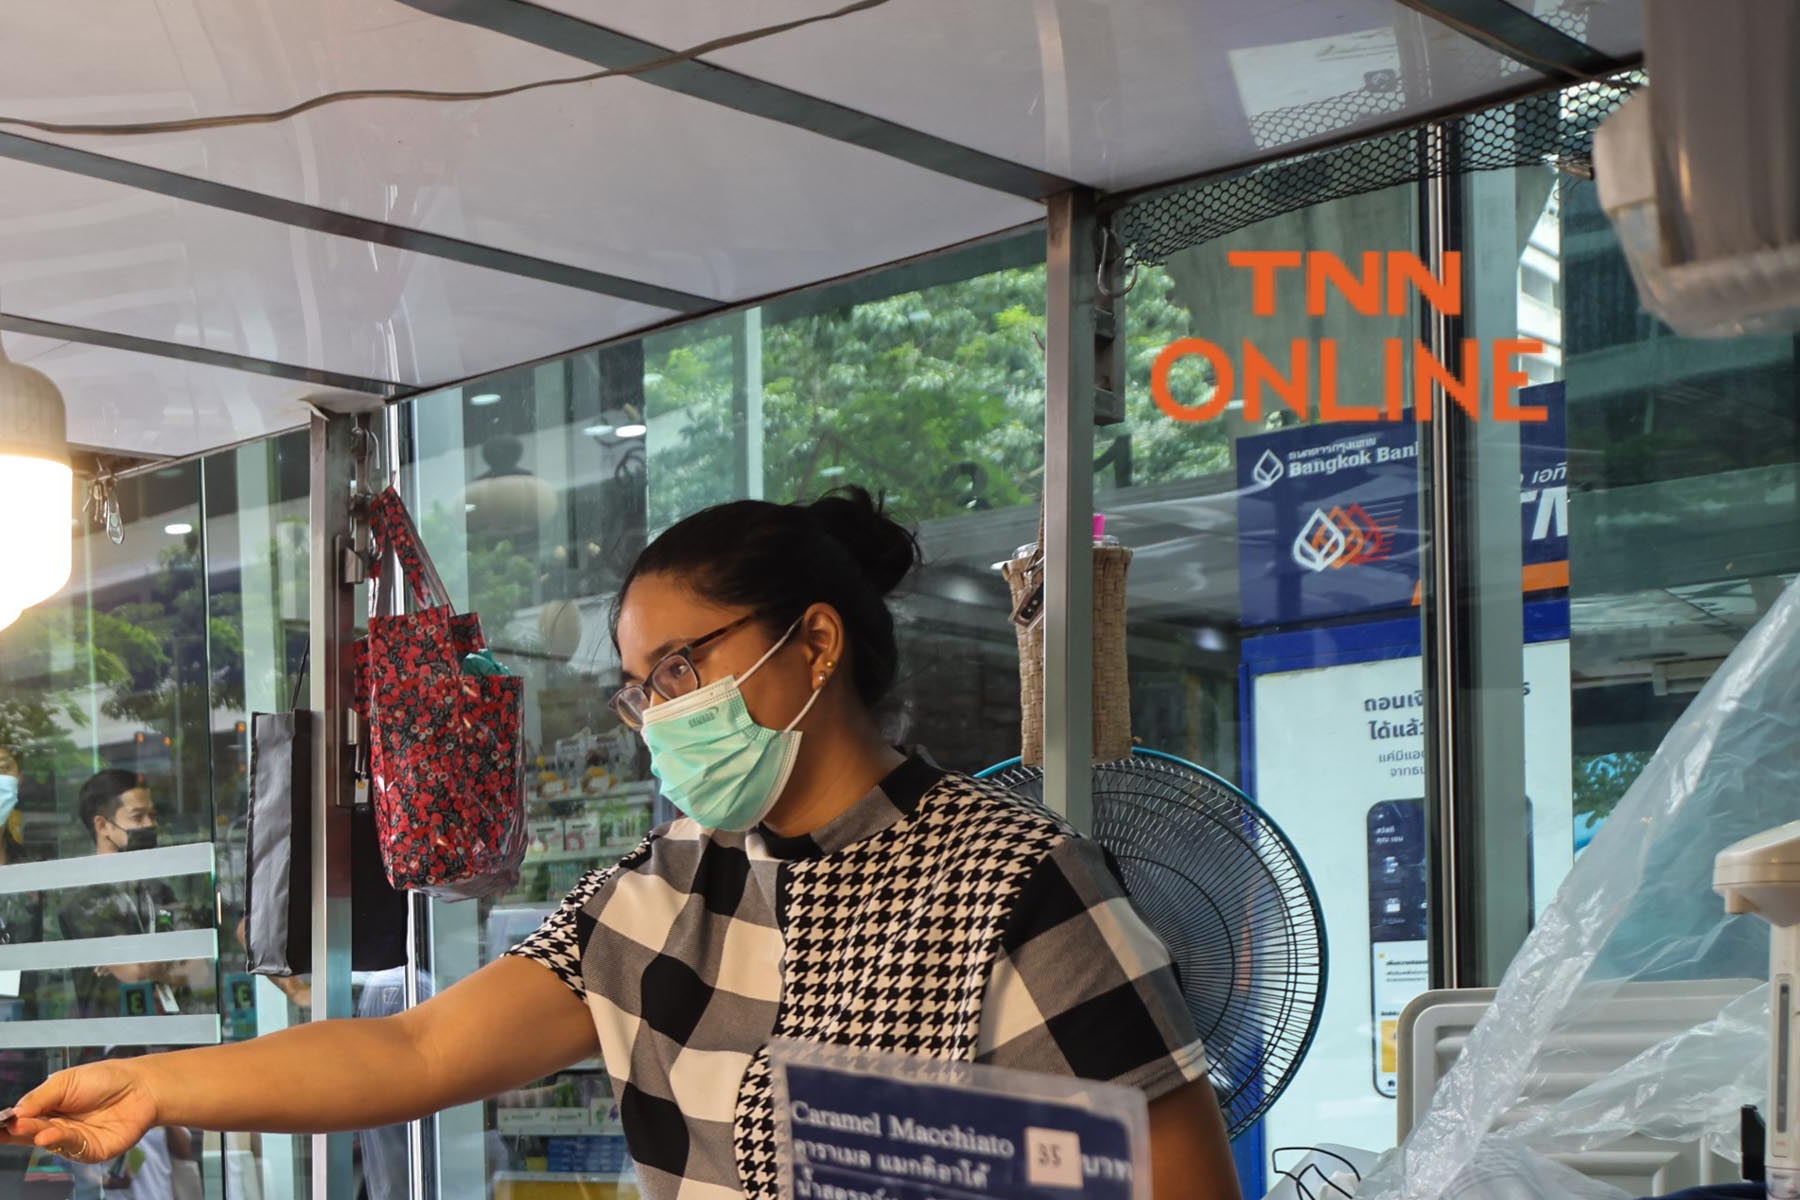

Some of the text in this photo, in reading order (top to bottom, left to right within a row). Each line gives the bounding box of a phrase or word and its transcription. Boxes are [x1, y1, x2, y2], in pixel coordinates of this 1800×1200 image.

[1288, 452, 1371, 478] Bangkok
[792, 1101, 881, 1137] Caramel
[888, 1114, 1015, 1158] Macchiato
[794, 1139, 872, 1168] คาราเมล
